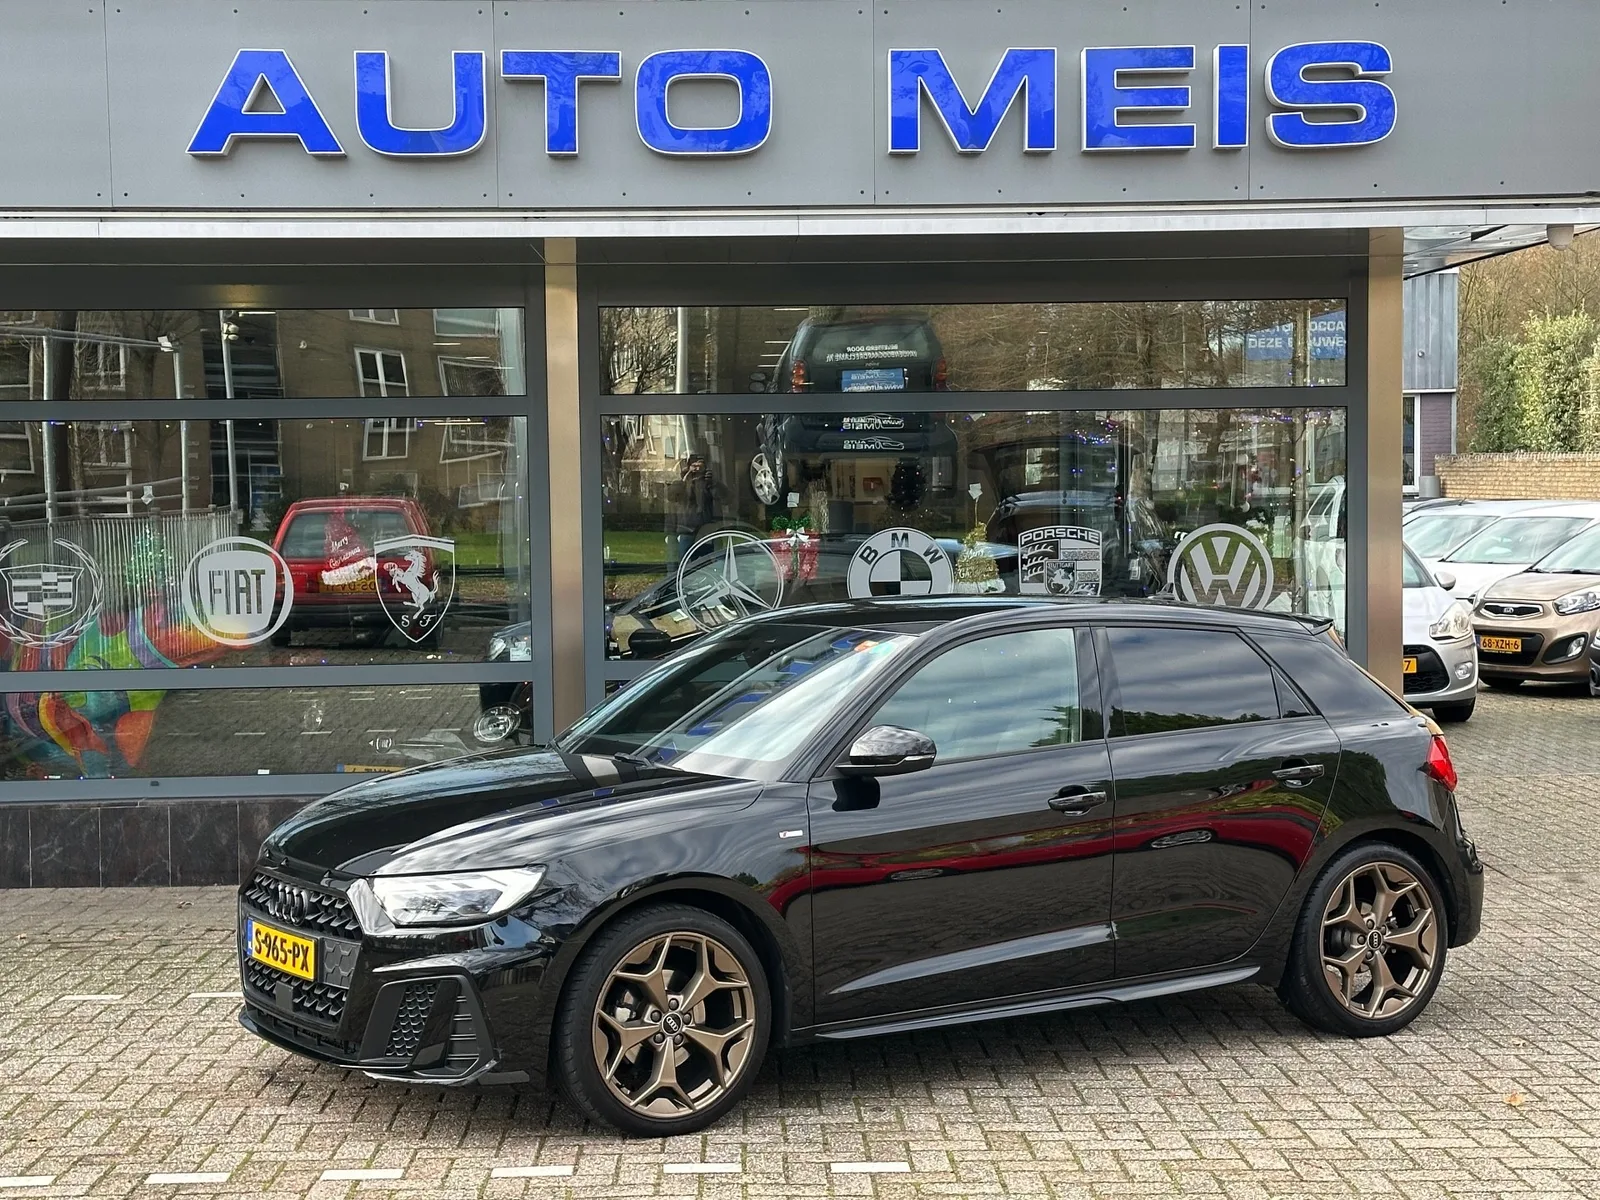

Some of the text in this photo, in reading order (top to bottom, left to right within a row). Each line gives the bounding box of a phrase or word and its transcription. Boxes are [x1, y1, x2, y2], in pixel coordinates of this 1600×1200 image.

[186, 41, 1398, 157] AUTO MEIS
[1248, 337, 1282, 349] DEZE
[859, 532, 943, 565] BMW
[1021, 528, 1099, 545] PORSCHE
[208, 569, 266, 616] FIAT
[401, 614, 437, 627] S F
[1482, 637, 1520, 651] 68-XZH-6
[254, 927, 310, 973] S-965-PX
